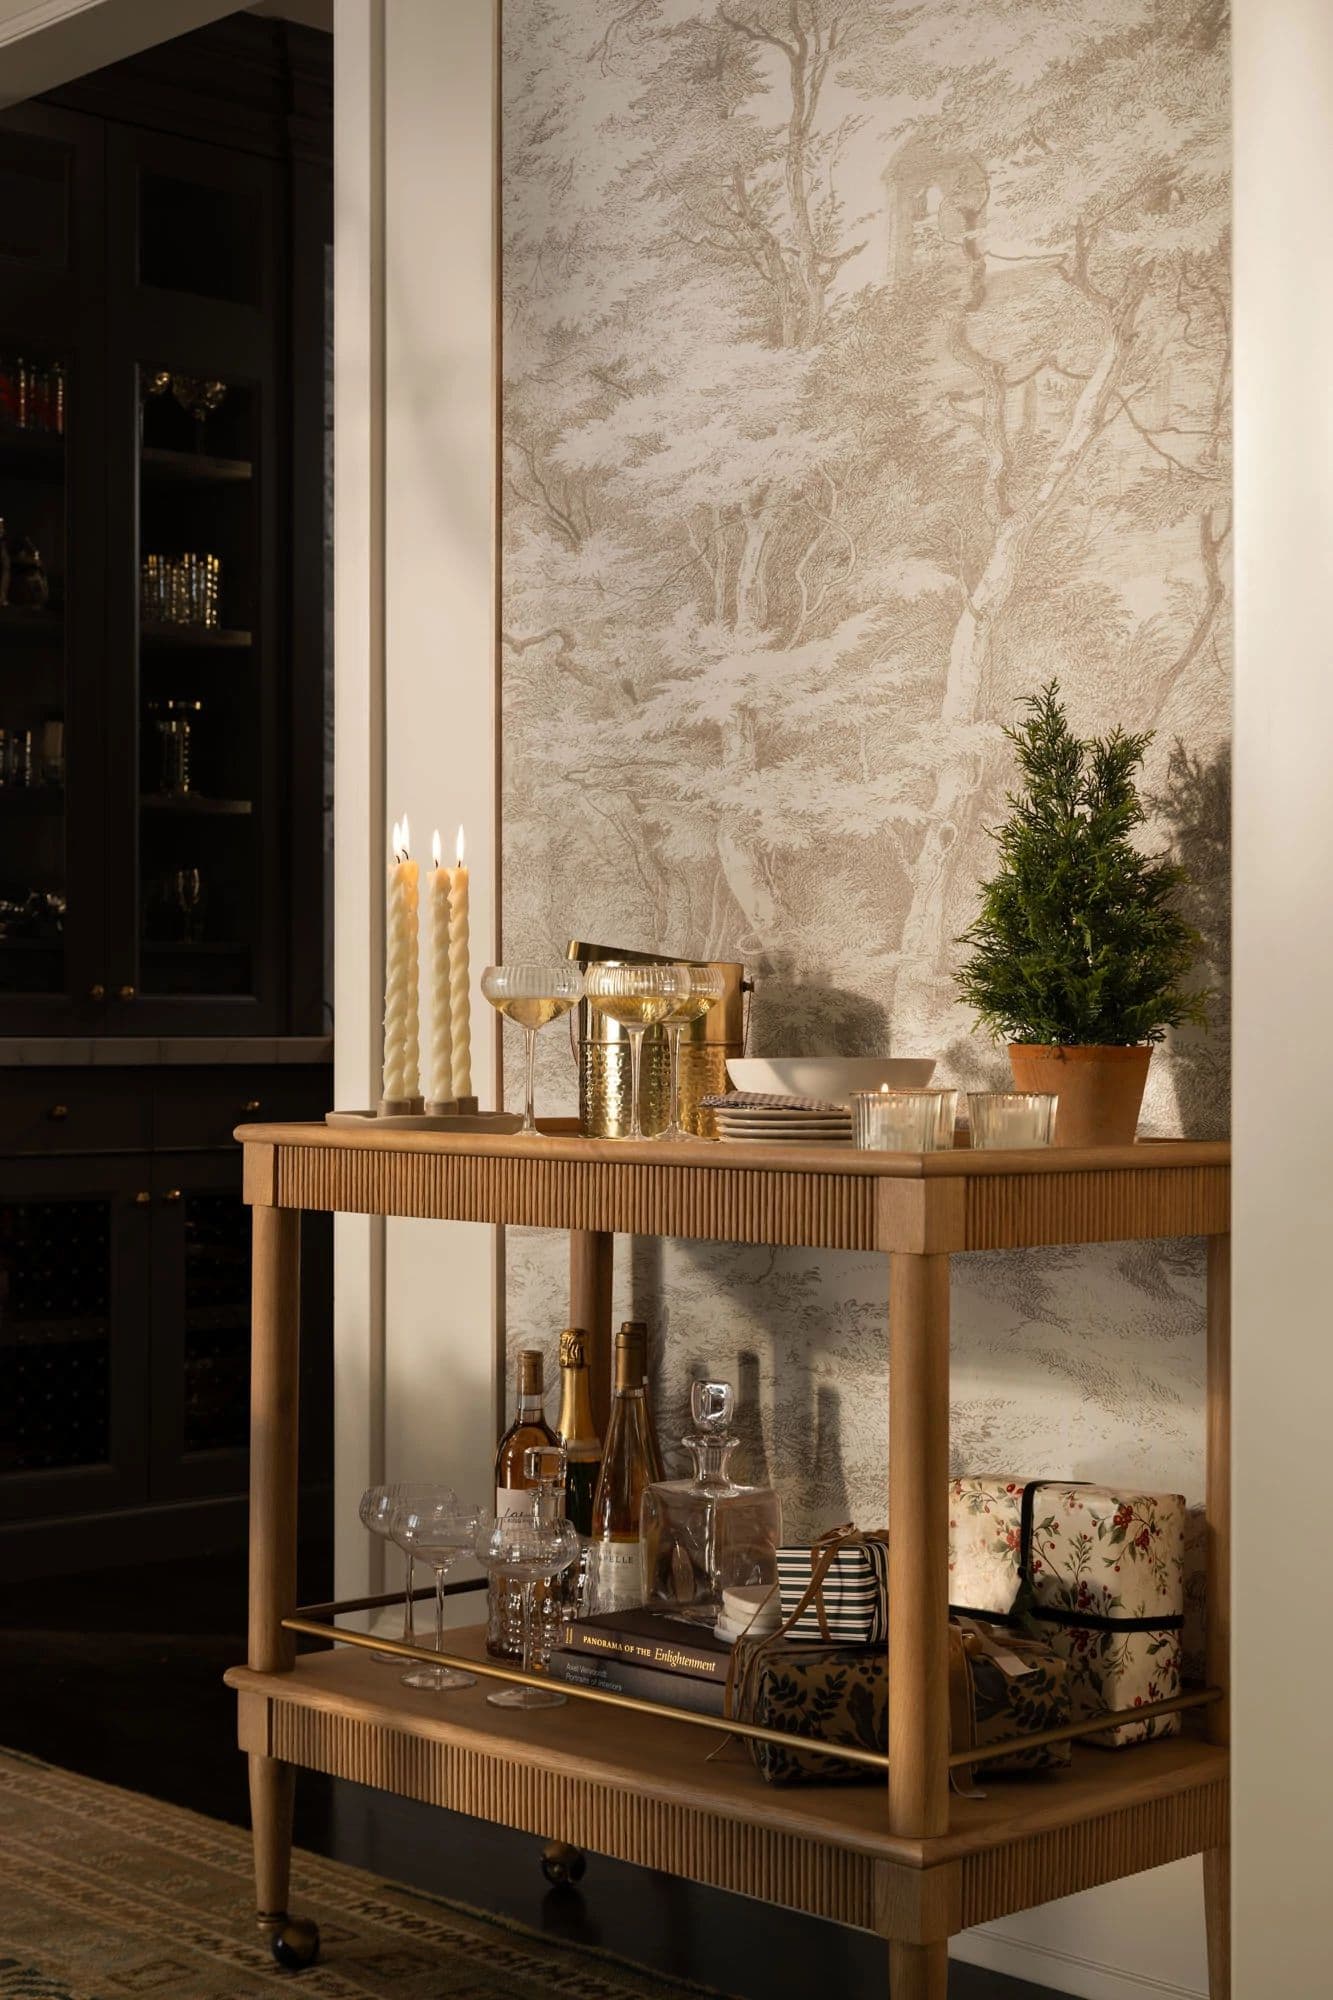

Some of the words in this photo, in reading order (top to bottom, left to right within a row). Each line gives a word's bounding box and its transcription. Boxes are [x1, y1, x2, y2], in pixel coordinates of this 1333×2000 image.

[583, 1635, 623, 1651] PANORAMA
[624, 1644, 635, 1653] OF
[637, 1647, 651, 1657] THE
[655, 1647, 716, 1671] Enlightenment
